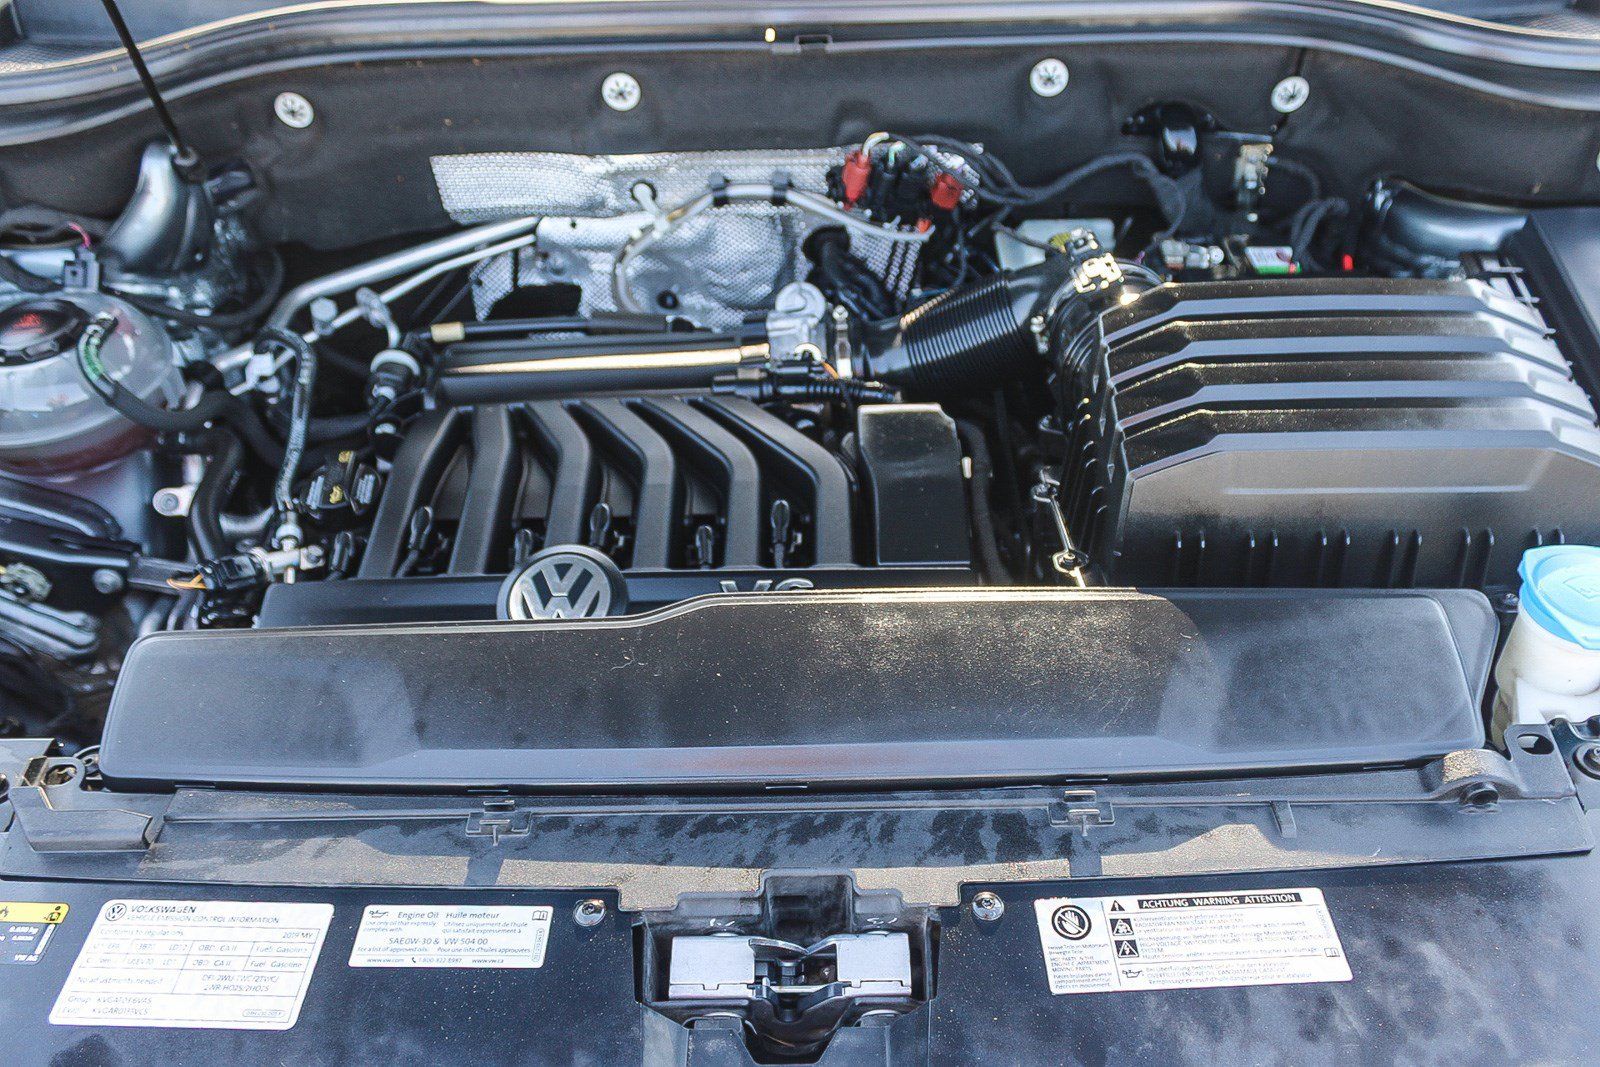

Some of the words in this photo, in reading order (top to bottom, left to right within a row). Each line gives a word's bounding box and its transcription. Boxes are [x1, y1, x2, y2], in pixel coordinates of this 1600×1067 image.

[1142, 899, 1189, 908] ACHTUNG
[1193, 896, 1240, 906] WARNING
[1244, 894, 1297, 904] ATTENTION
[131, 904, 197, 914] VOLKSWAGEN
[397, 911, 425, 920] Engine
[427, 911, 440, 919] Oil
[271, 961, 303, 969] Gasoline
